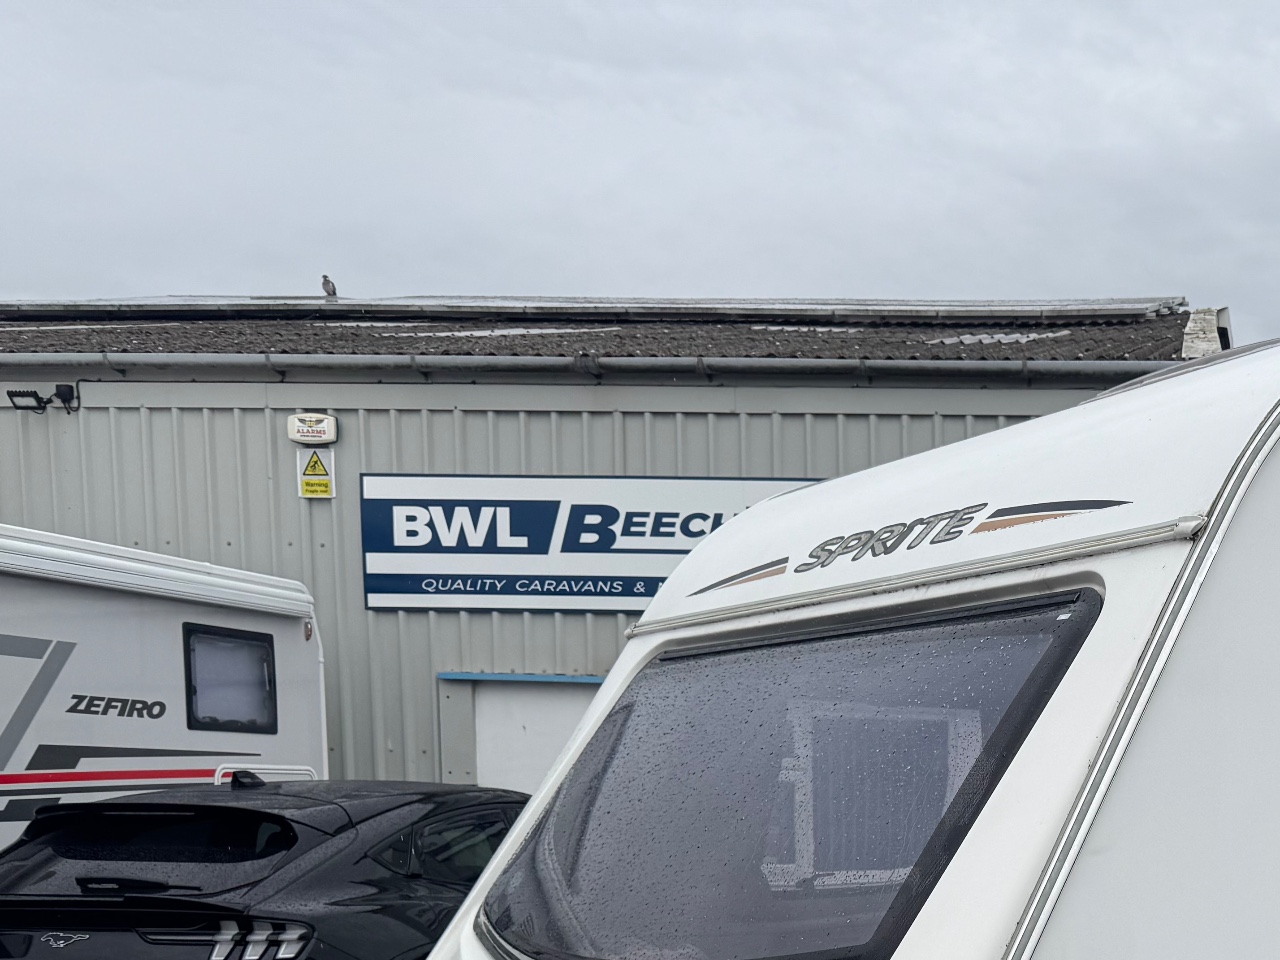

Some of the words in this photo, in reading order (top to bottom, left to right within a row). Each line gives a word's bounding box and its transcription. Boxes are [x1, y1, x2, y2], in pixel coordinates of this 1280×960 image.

[305, 481, 328, 489] Warning
[392, 505, 529, 548] BWL
[794, 502, 989, 574] SPRITE
[421, 578, 507, 593] QUALITY
[515, 579, 623, 593] CARAVANS
[633, 582, 646, 593] &
[65, 694, 167, 720] ZEFIRO
